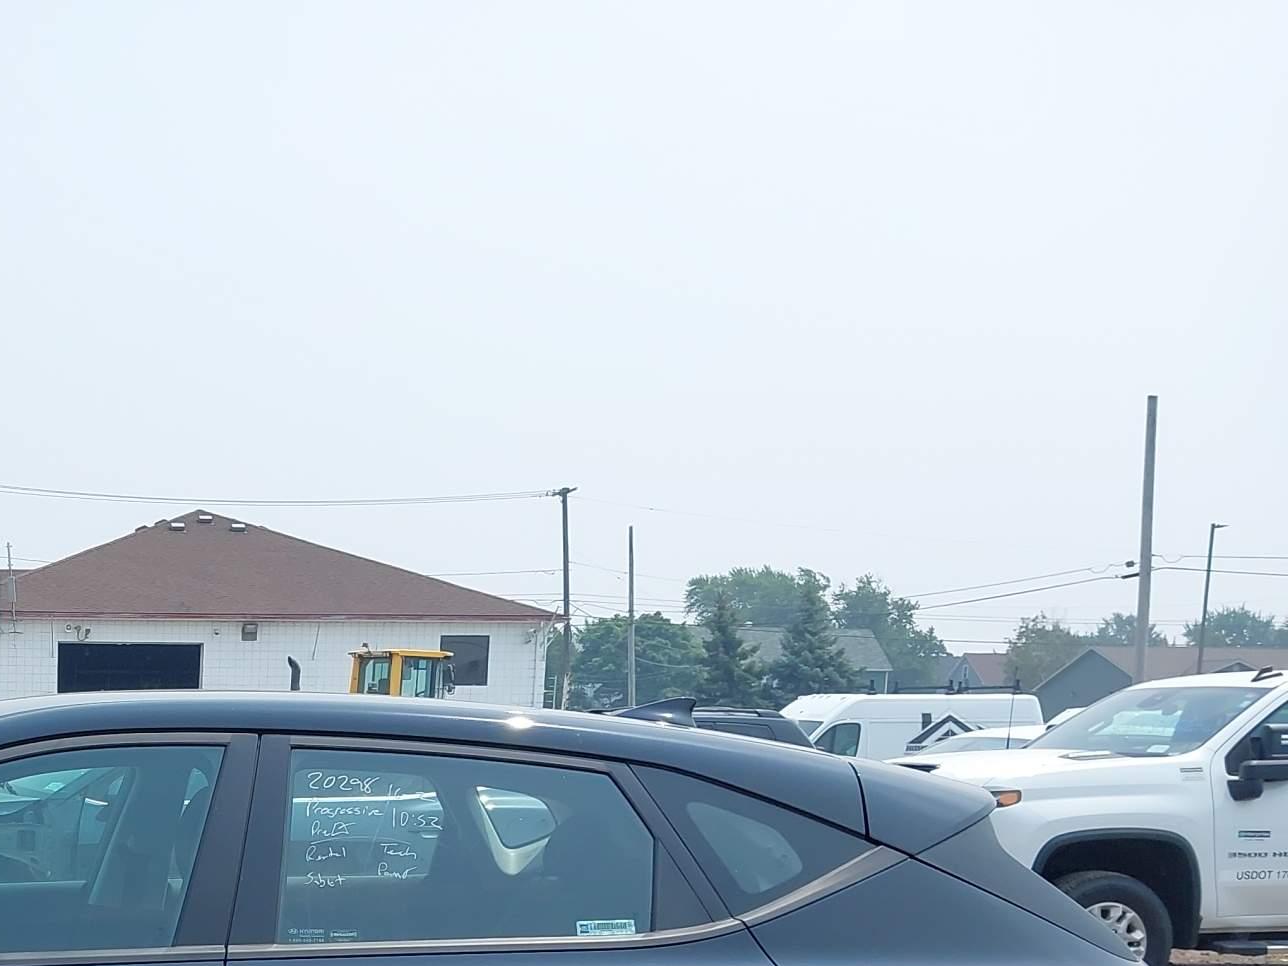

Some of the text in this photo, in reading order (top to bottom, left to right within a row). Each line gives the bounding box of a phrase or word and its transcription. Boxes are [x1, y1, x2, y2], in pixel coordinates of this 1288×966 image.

[307, 771, 380, 794] 20298
[1236, 870, 1288, 880] USDOT 17
